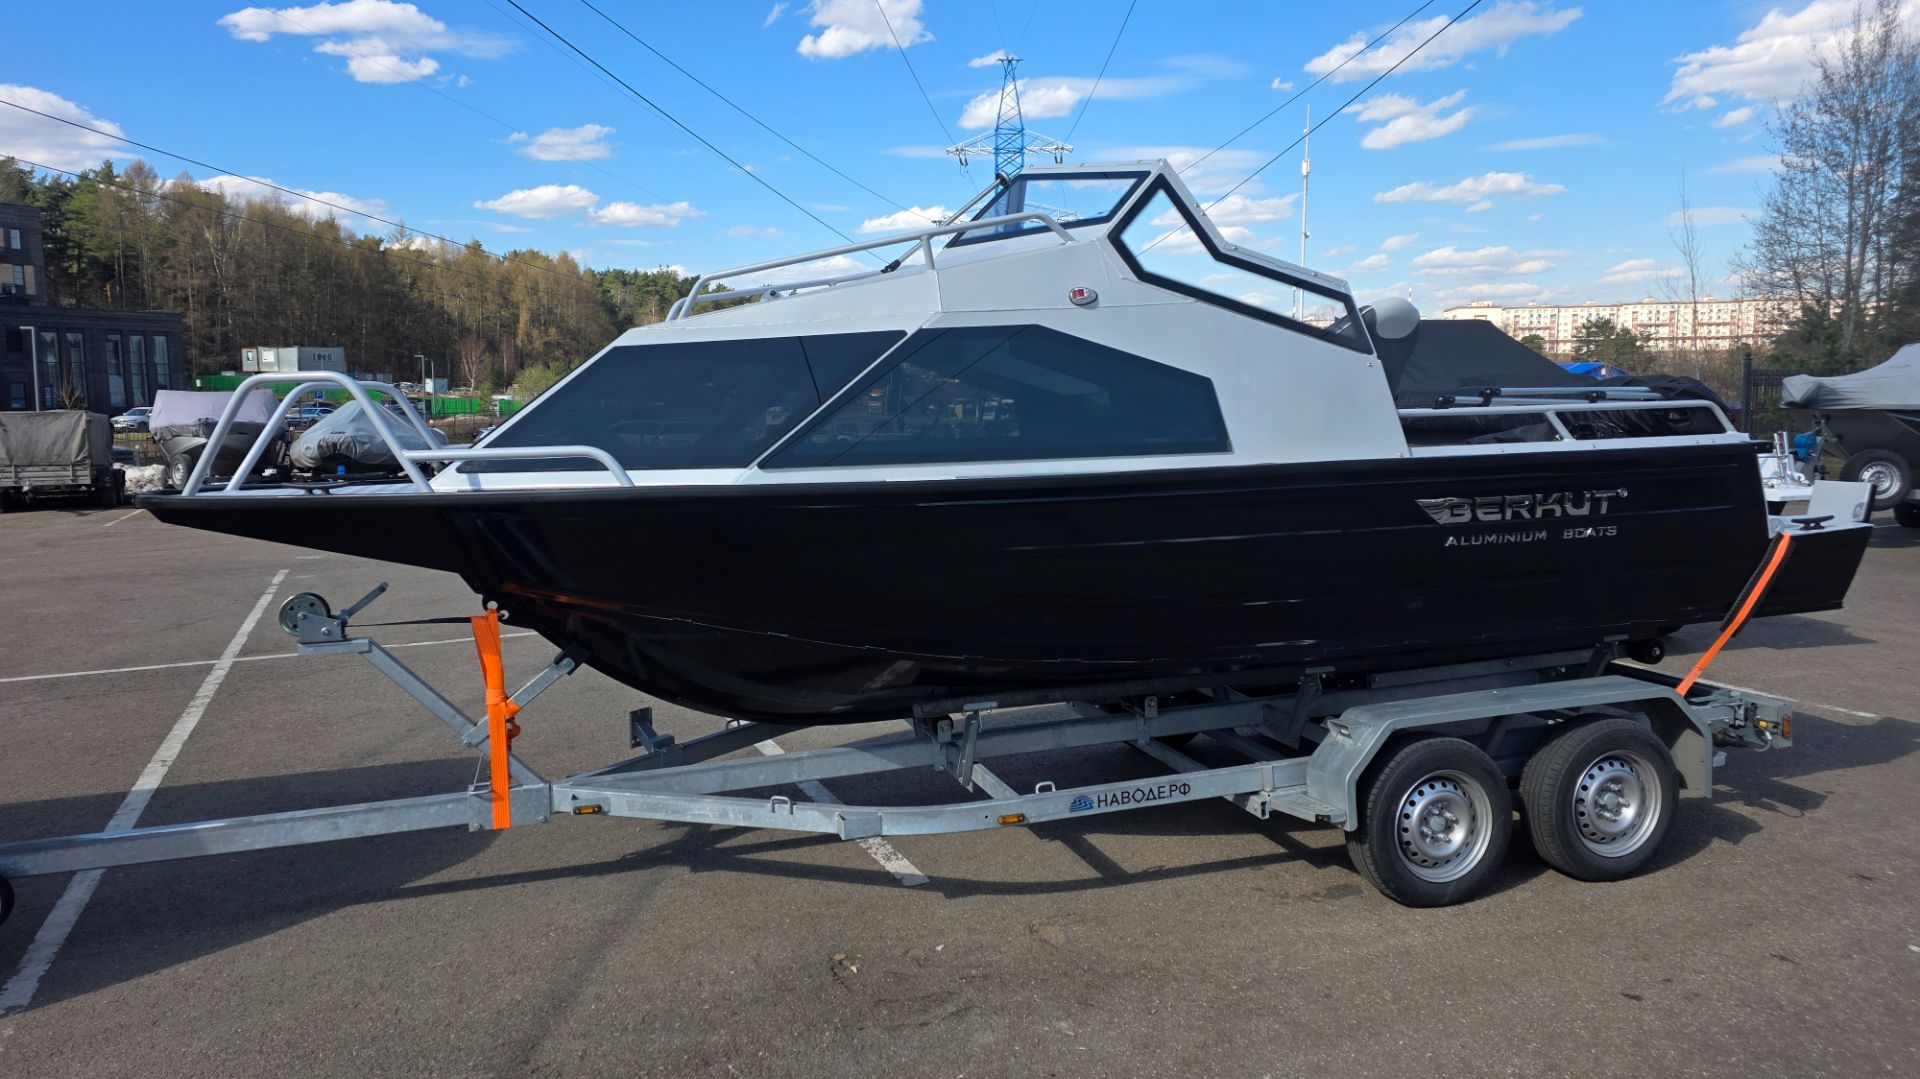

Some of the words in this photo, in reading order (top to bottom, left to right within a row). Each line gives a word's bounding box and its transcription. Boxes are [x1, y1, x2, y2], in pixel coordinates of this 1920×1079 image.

[1447, 490, 1618, 524] BERKUT
[1445, 530, 1548, 547] ALUMINIUM
[1563, 525, 1618, 540] BOATS
